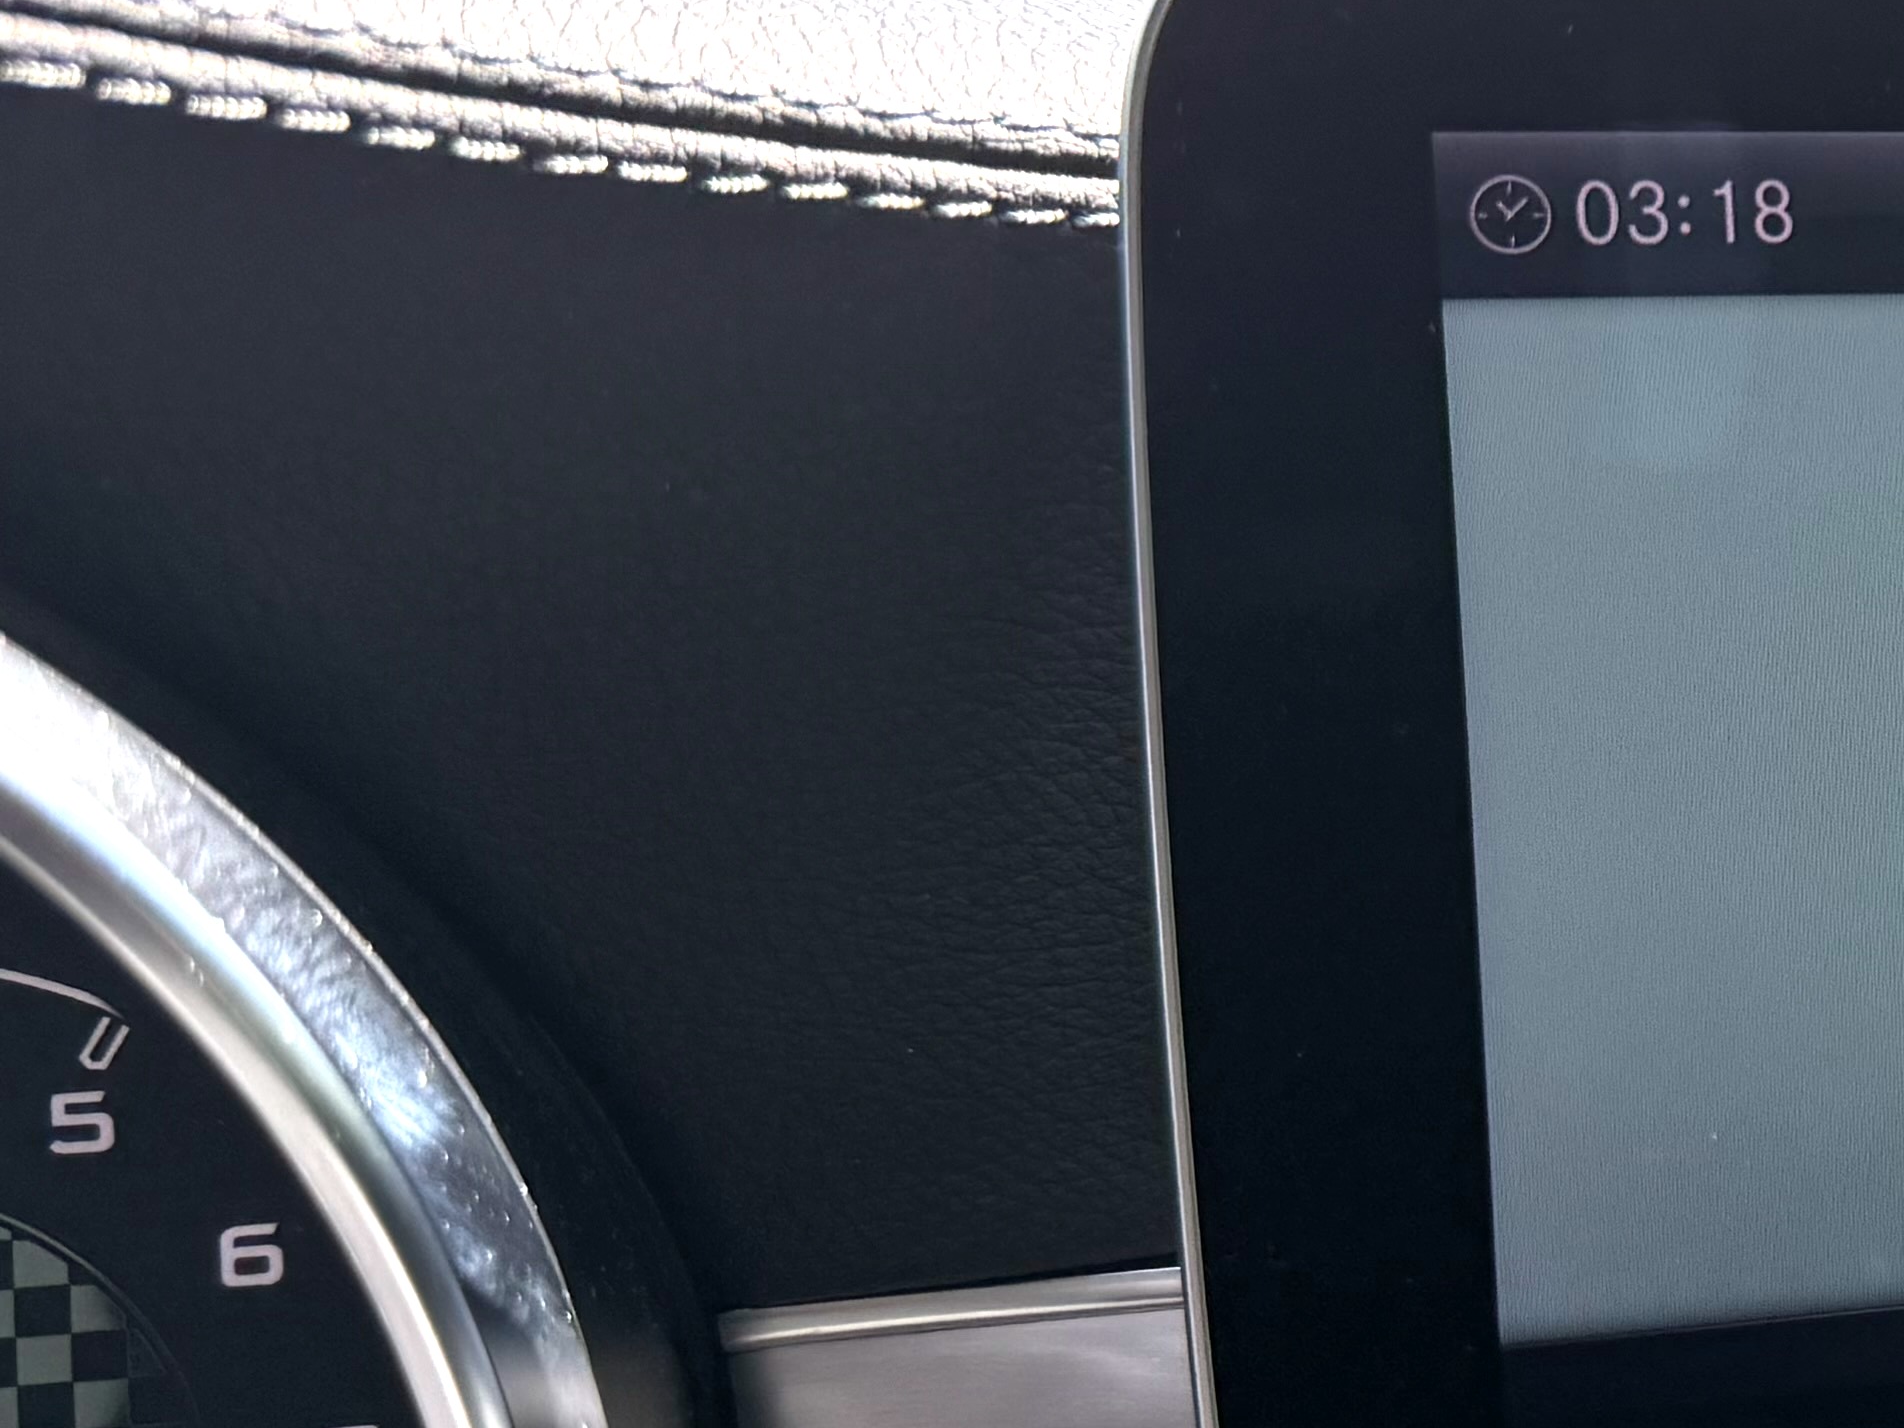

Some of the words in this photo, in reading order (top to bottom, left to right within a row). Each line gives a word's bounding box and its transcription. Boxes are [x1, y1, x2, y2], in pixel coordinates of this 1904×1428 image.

[1575, 178, 1795, 247] 03:18
[48, 1089, 116, 1155] 5
[218, 1222, 285, 1288] 6
